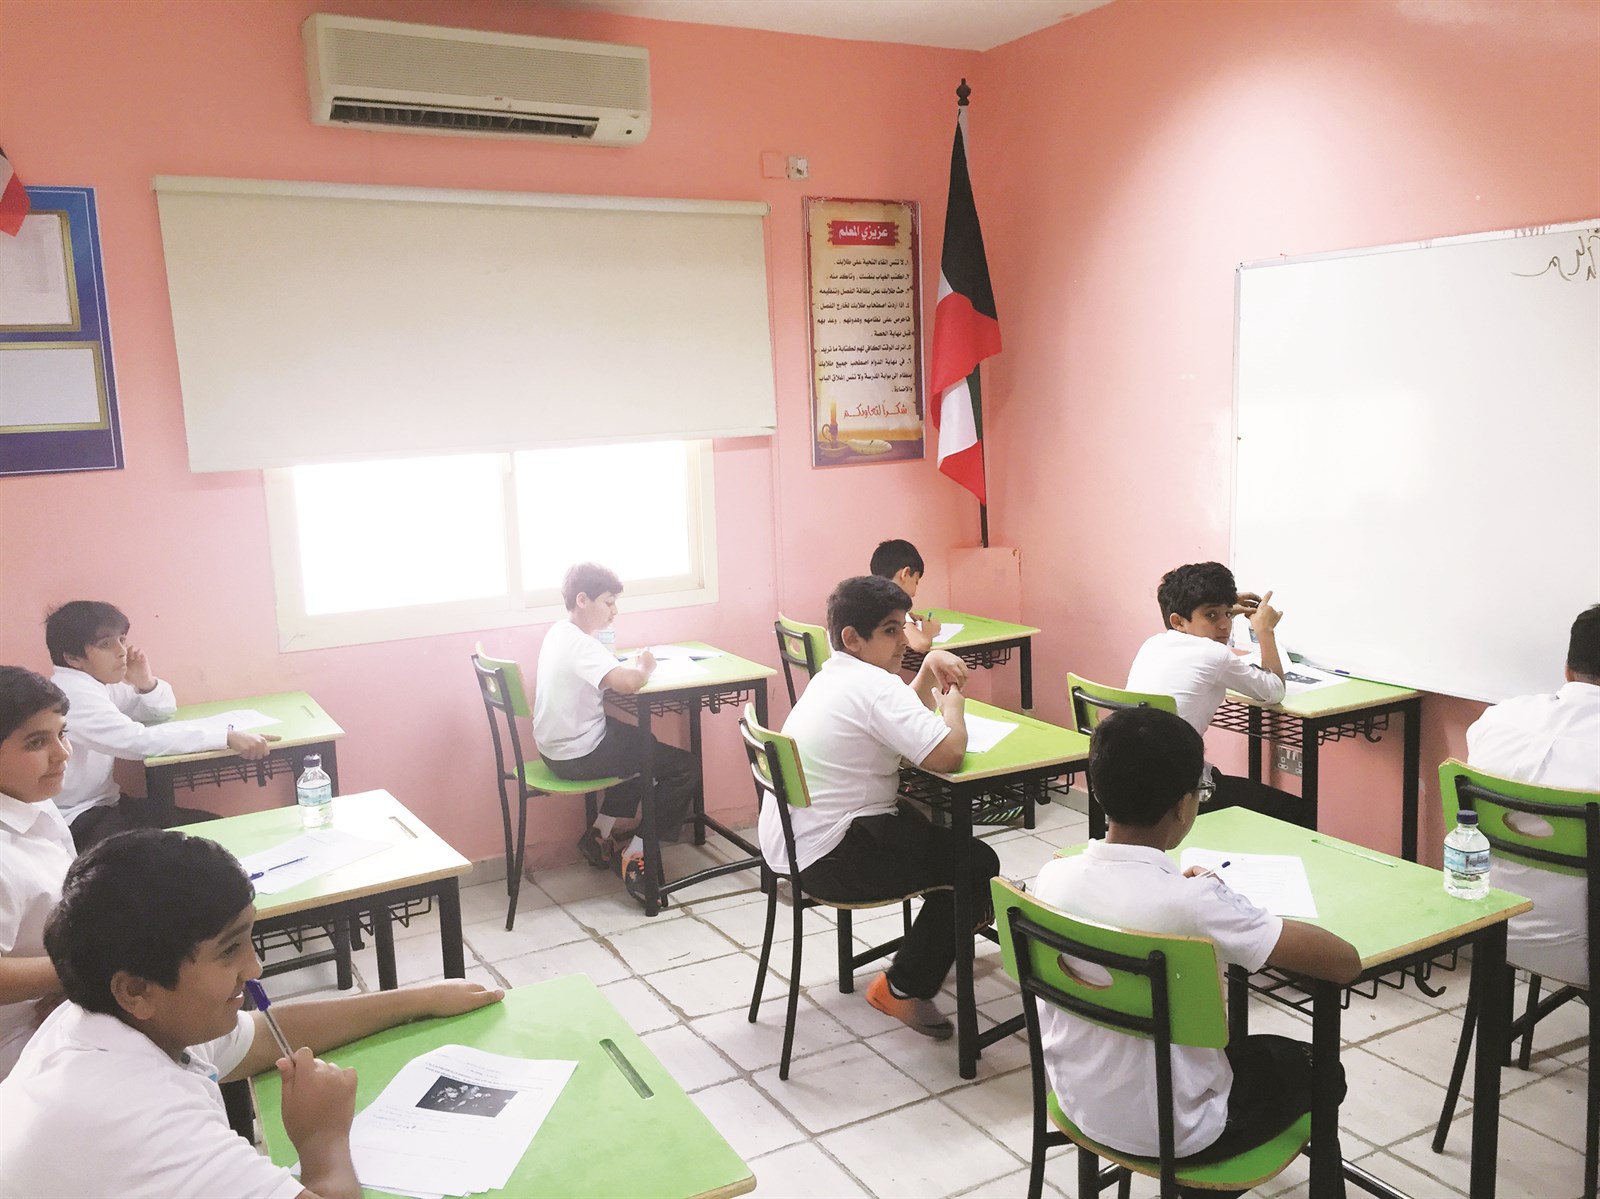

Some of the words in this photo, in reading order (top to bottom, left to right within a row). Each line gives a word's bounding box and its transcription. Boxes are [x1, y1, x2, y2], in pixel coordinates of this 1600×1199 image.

[838, 225, 860, 239] المعلم
[861, 225, 888, 240] عزيزي
[844, 404, 881, 419] لتعاونكم
